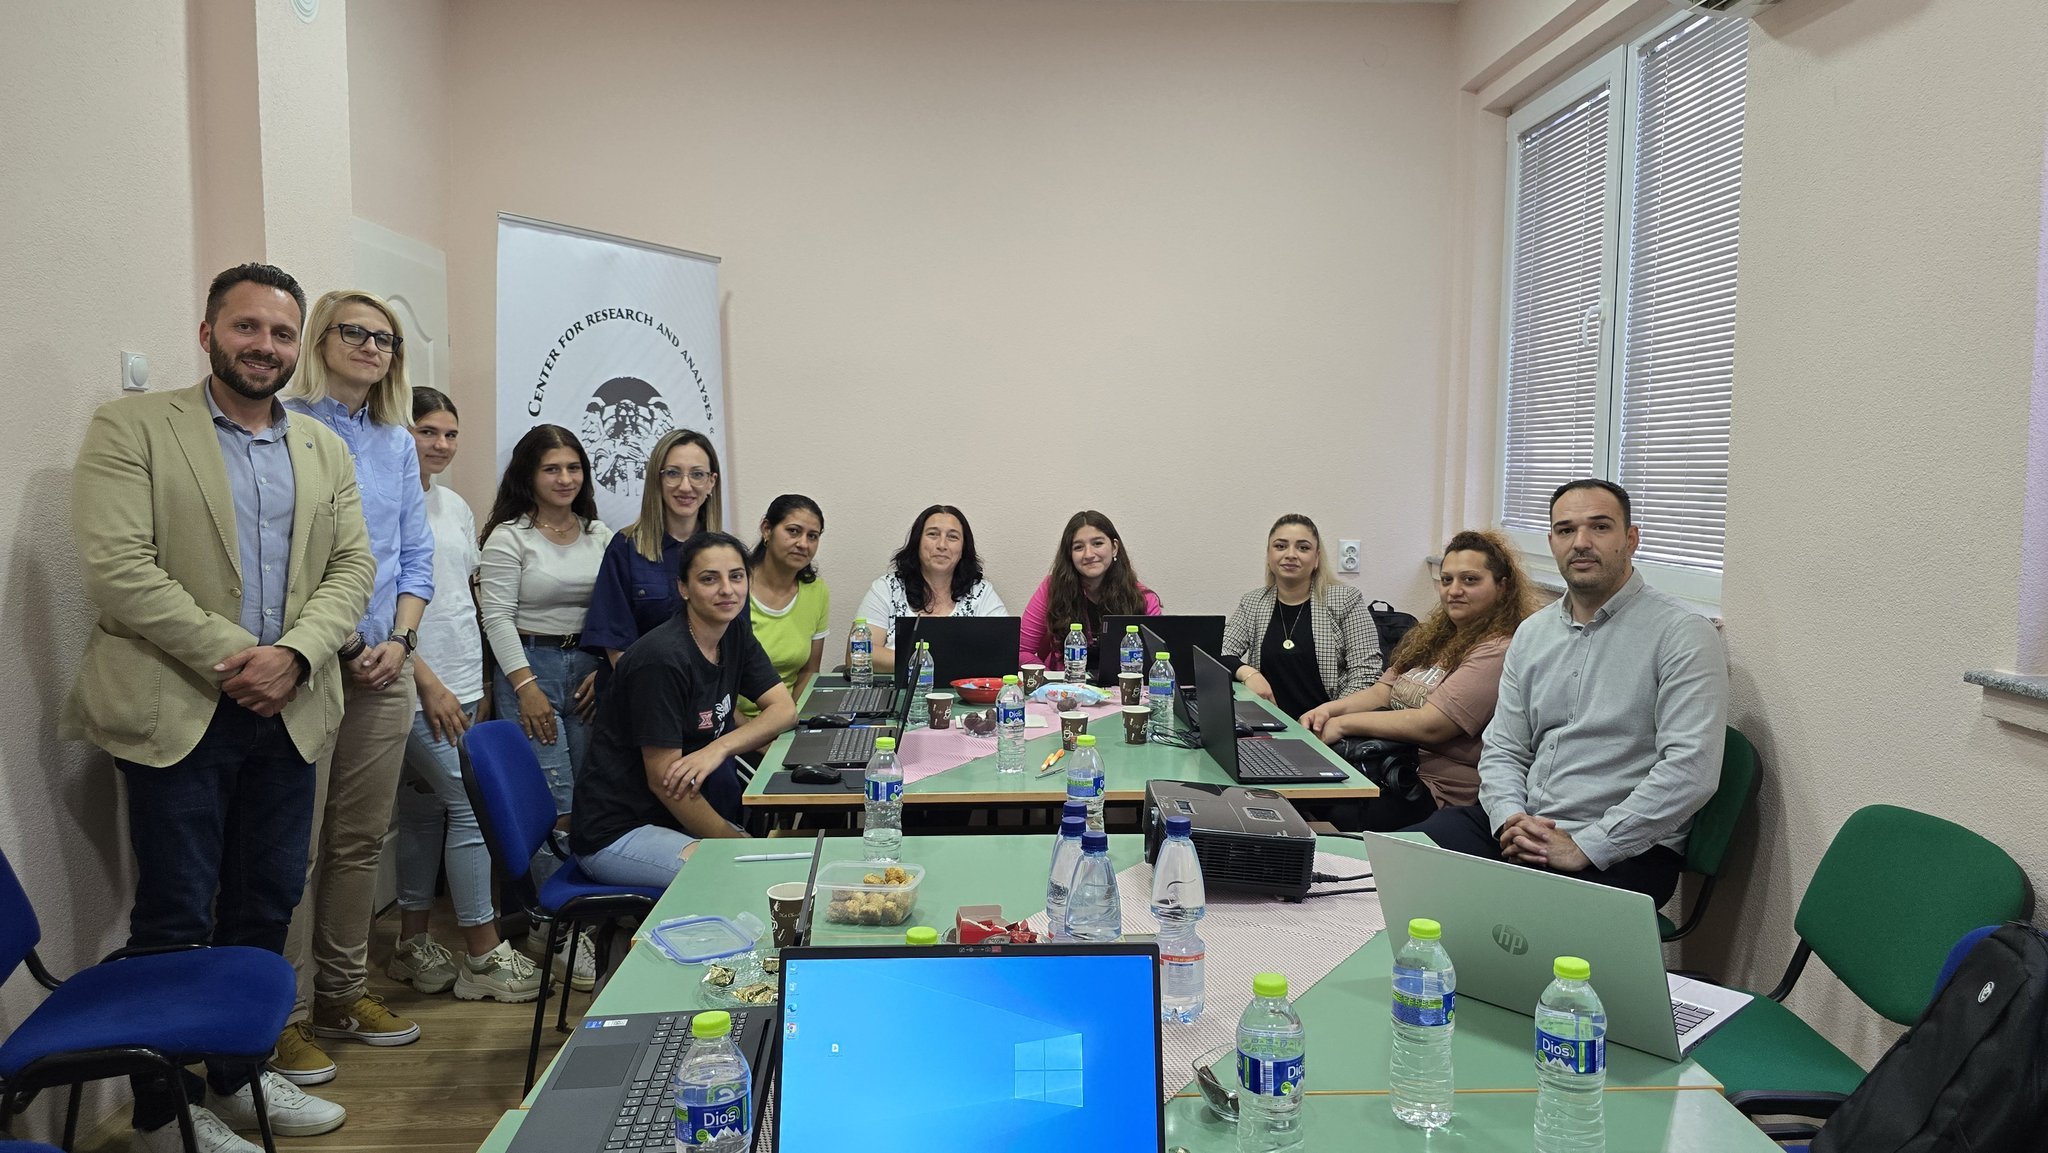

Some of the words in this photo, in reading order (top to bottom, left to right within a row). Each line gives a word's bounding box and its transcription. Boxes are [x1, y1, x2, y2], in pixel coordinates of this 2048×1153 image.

[528, 348, 560, 417] CENTER
[558, 321, 584, 349] FOR
[585, 307, 653, 326] RESEARCH
[656, 322, 680, 347] AND
[680, 349, 713, 421] ANALYSES
[1498, 924, 1524, 957] hp
[1543, 1037, 1570, 1057] Dios
[1287, 1063, 1304, 1079] Dio
[703, 1111, 736, 1127] Dios
